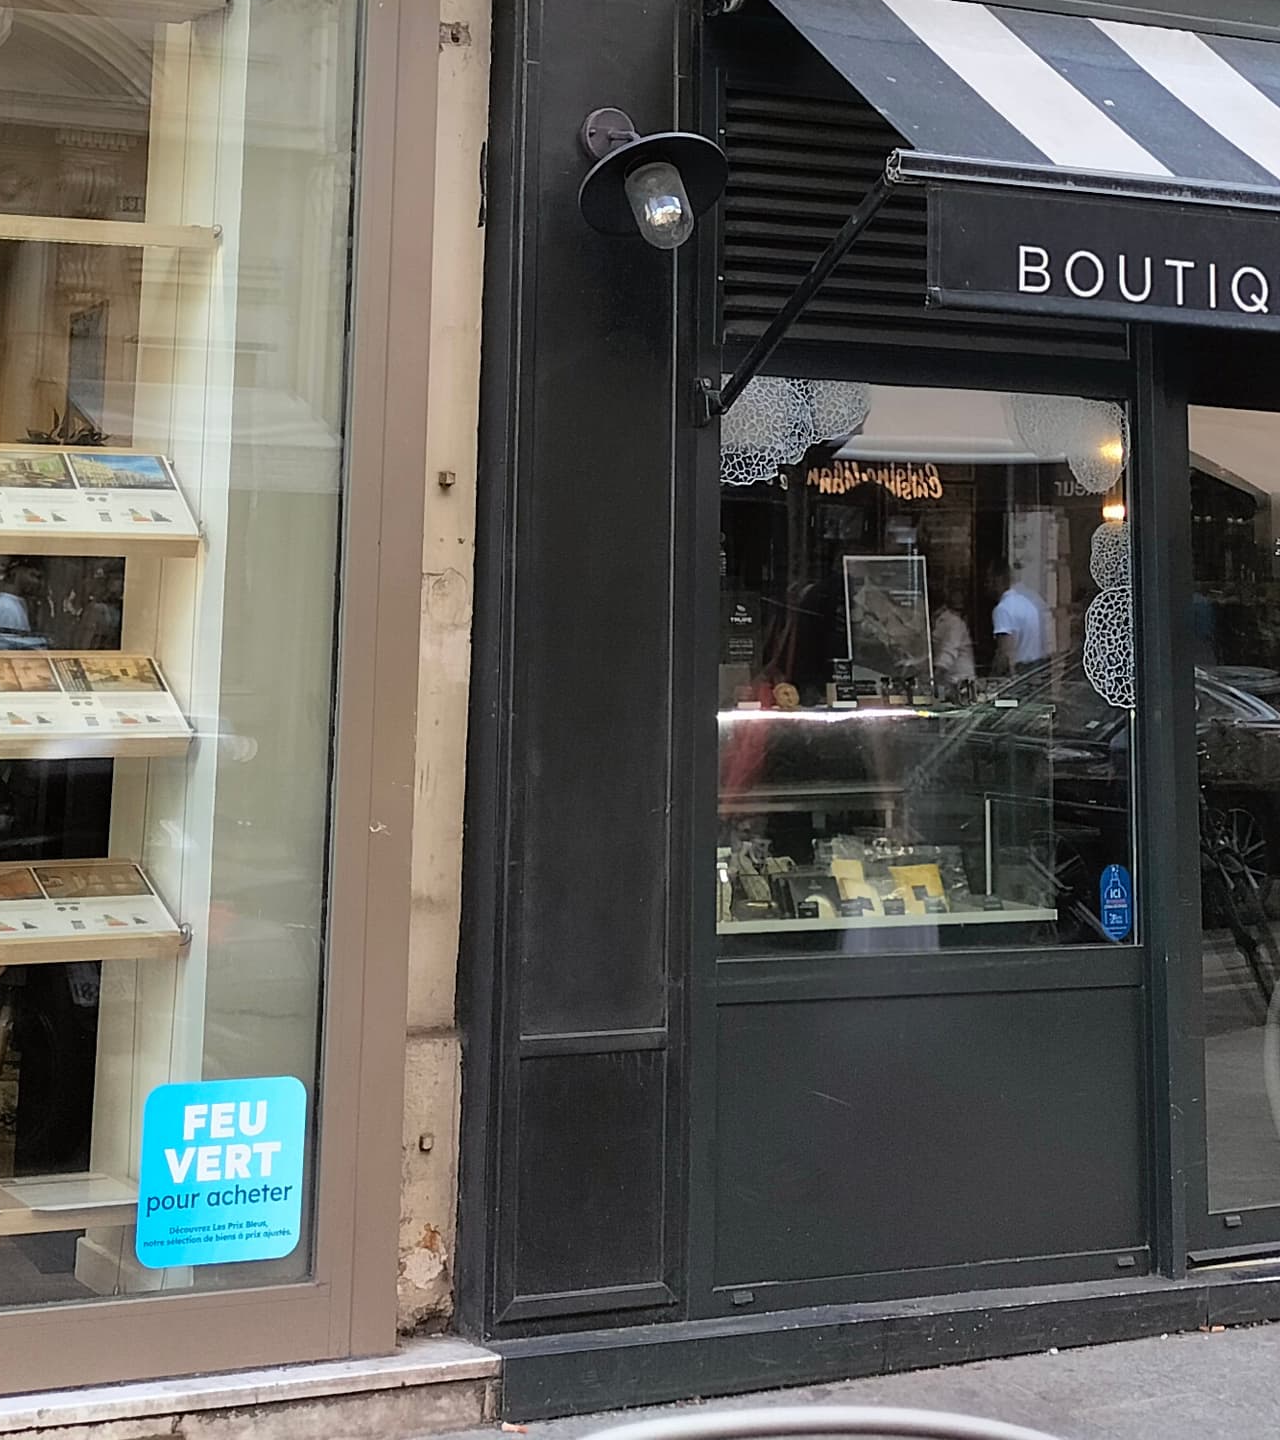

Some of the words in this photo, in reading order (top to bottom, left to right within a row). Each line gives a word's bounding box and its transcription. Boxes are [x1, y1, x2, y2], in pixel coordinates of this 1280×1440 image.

[183, 1100, 268, 1140] FEU
[164, 1141, 282, 1184] VERT
[146, 1192, 200, 1217] pour
[207, 1185, 293, 1206] acheter
